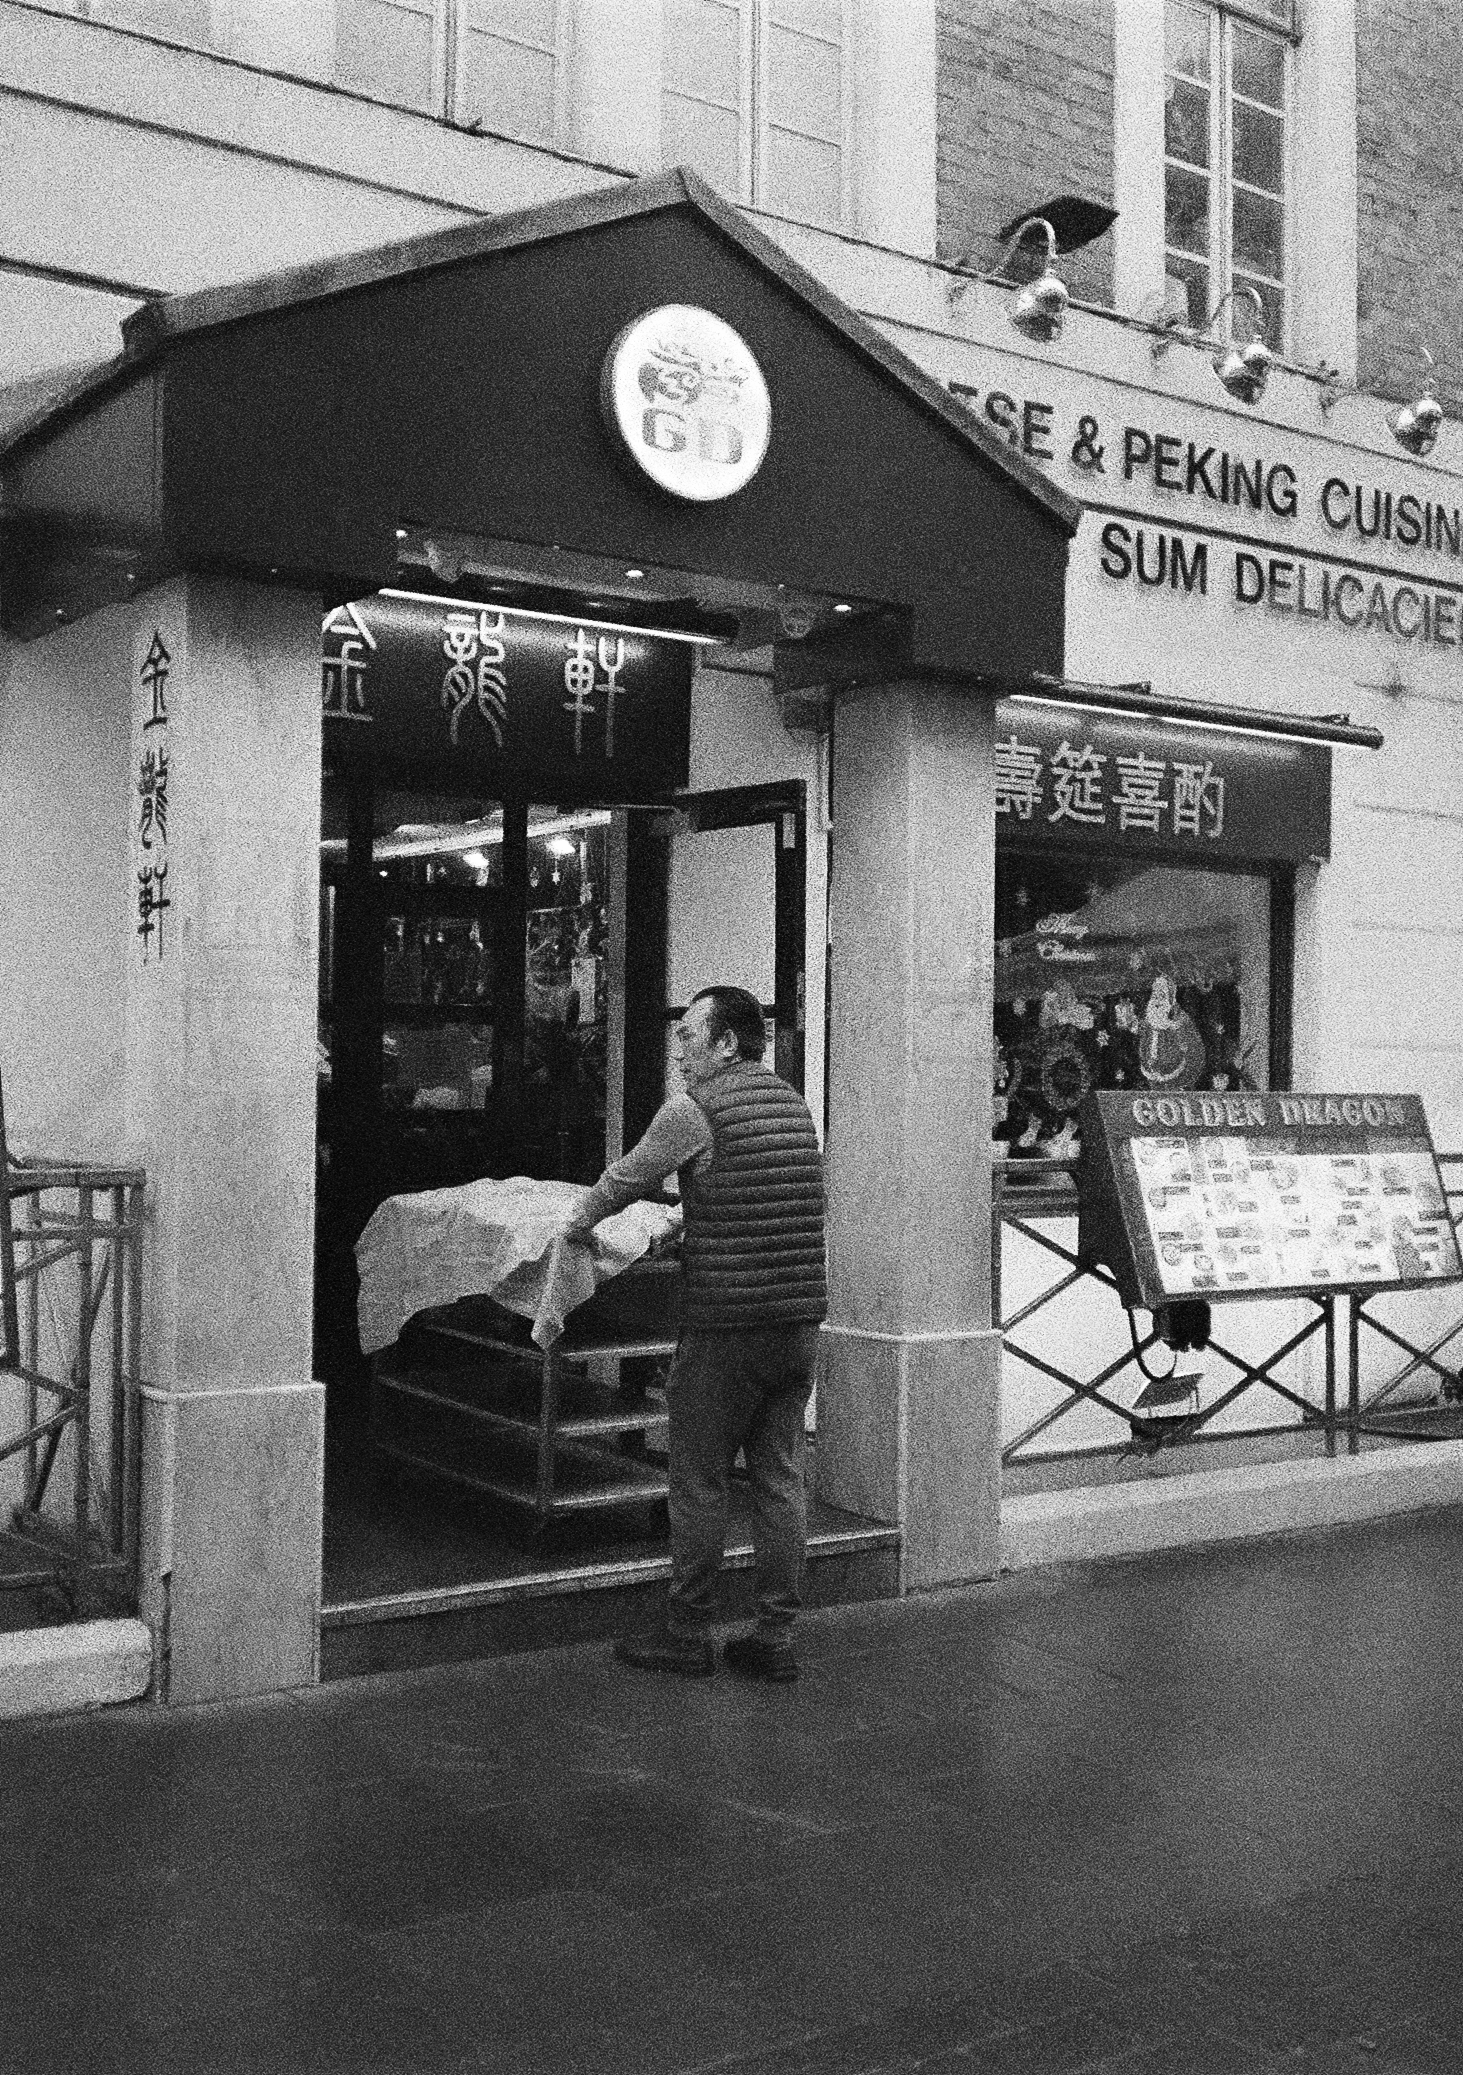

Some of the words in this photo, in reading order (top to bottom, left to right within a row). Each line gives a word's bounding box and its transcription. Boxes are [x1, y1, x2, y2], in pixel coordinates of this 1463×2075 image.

[642, 407, 743, 465] GD
[1071, 415, 1104, 474] &
[1124, 426, 1297, 518] PEKING
[1101, 523, 1208, 596] SUM
[1235, 552, 1463, 647] DELICACIE
[1132, 1097, 1266, 1128] GOLDEN
[1279, 1097, 1406, 1127] DRAGON
